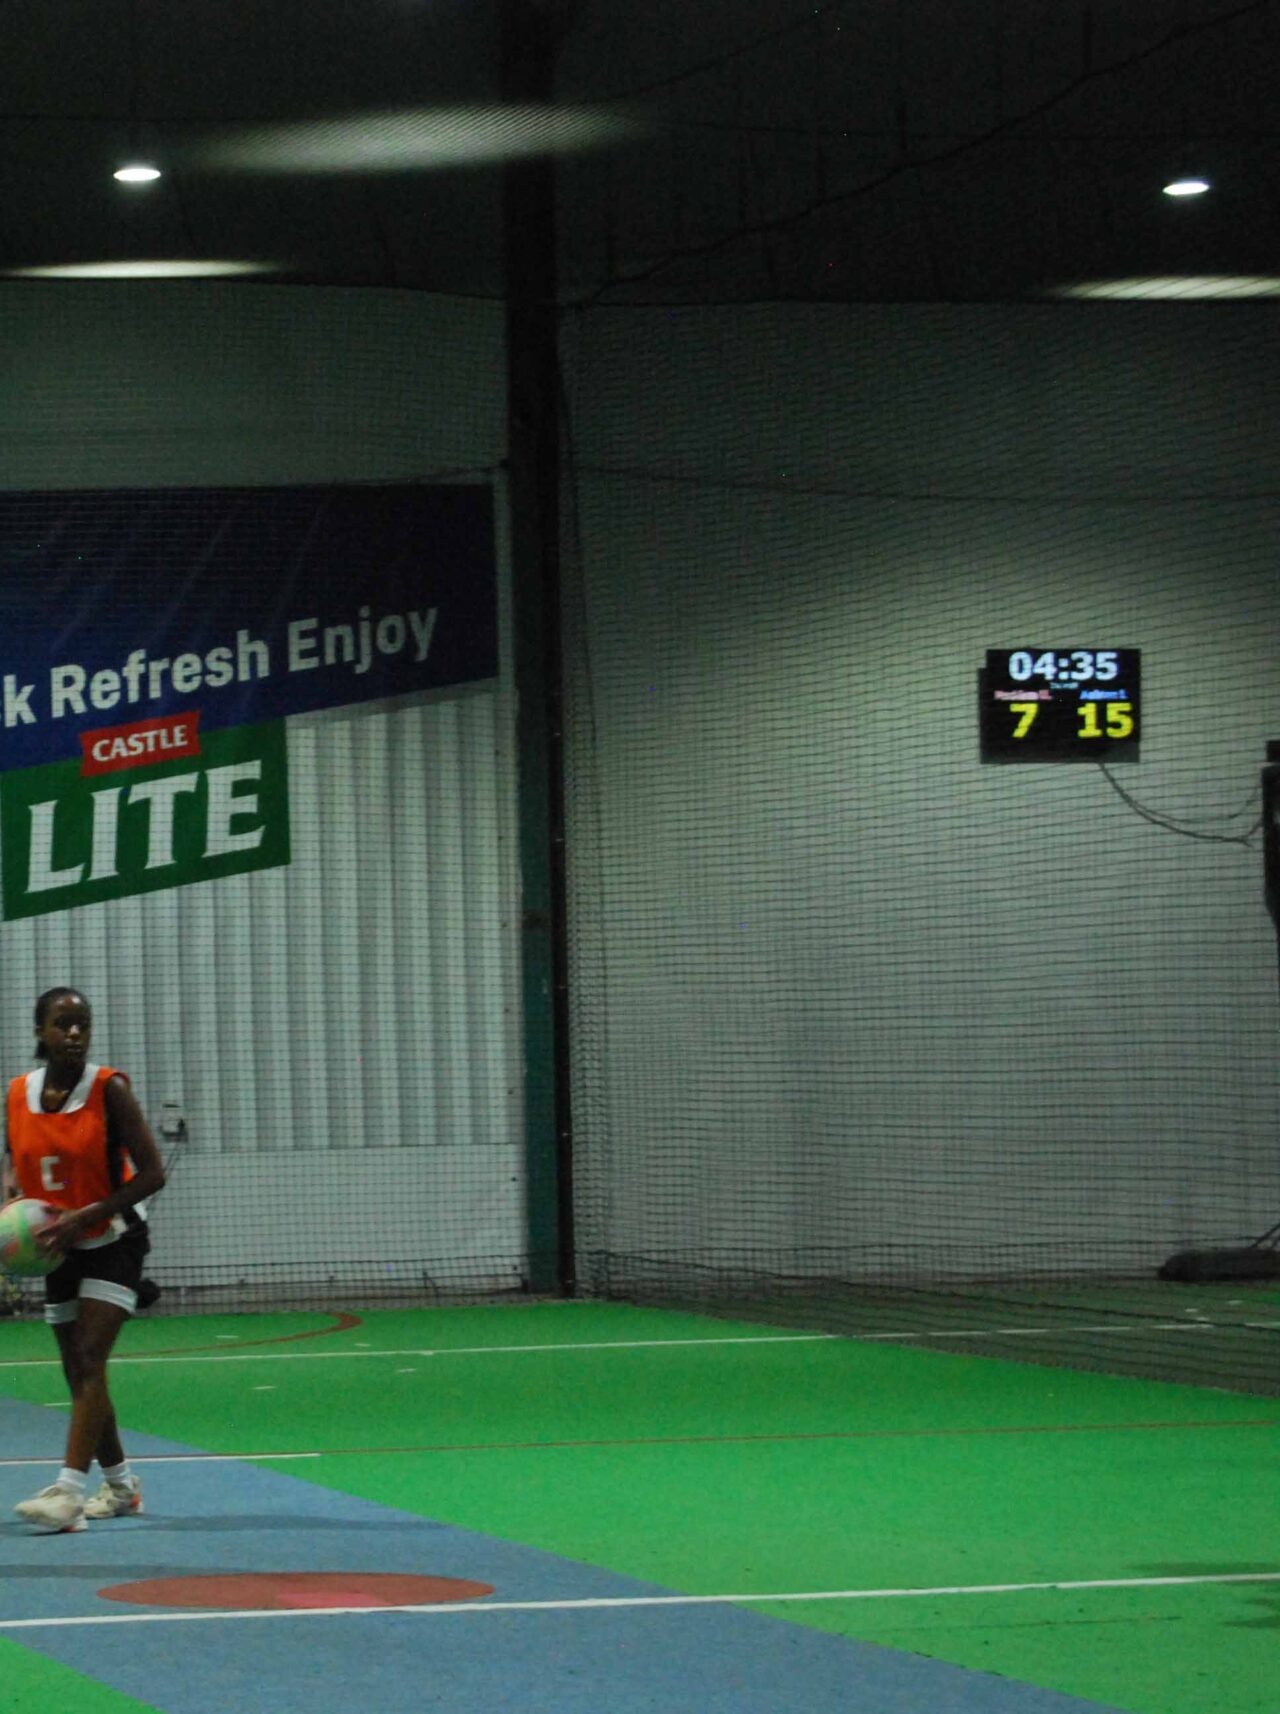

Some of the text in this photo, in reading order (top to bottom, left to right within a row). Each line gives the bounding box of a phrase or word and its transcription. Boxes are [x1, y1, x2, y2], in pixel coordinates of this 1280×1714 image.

[50, 628, 270, 718] Refresh
[287, 605, 439, 674] Enjoy
[1009, 651, 1118, 681] 04:35
[1009, 702, 1134, 739] 7 15
[91, 724, 189, 763] CASTLE
[24, 758, 267, 894] LITE
